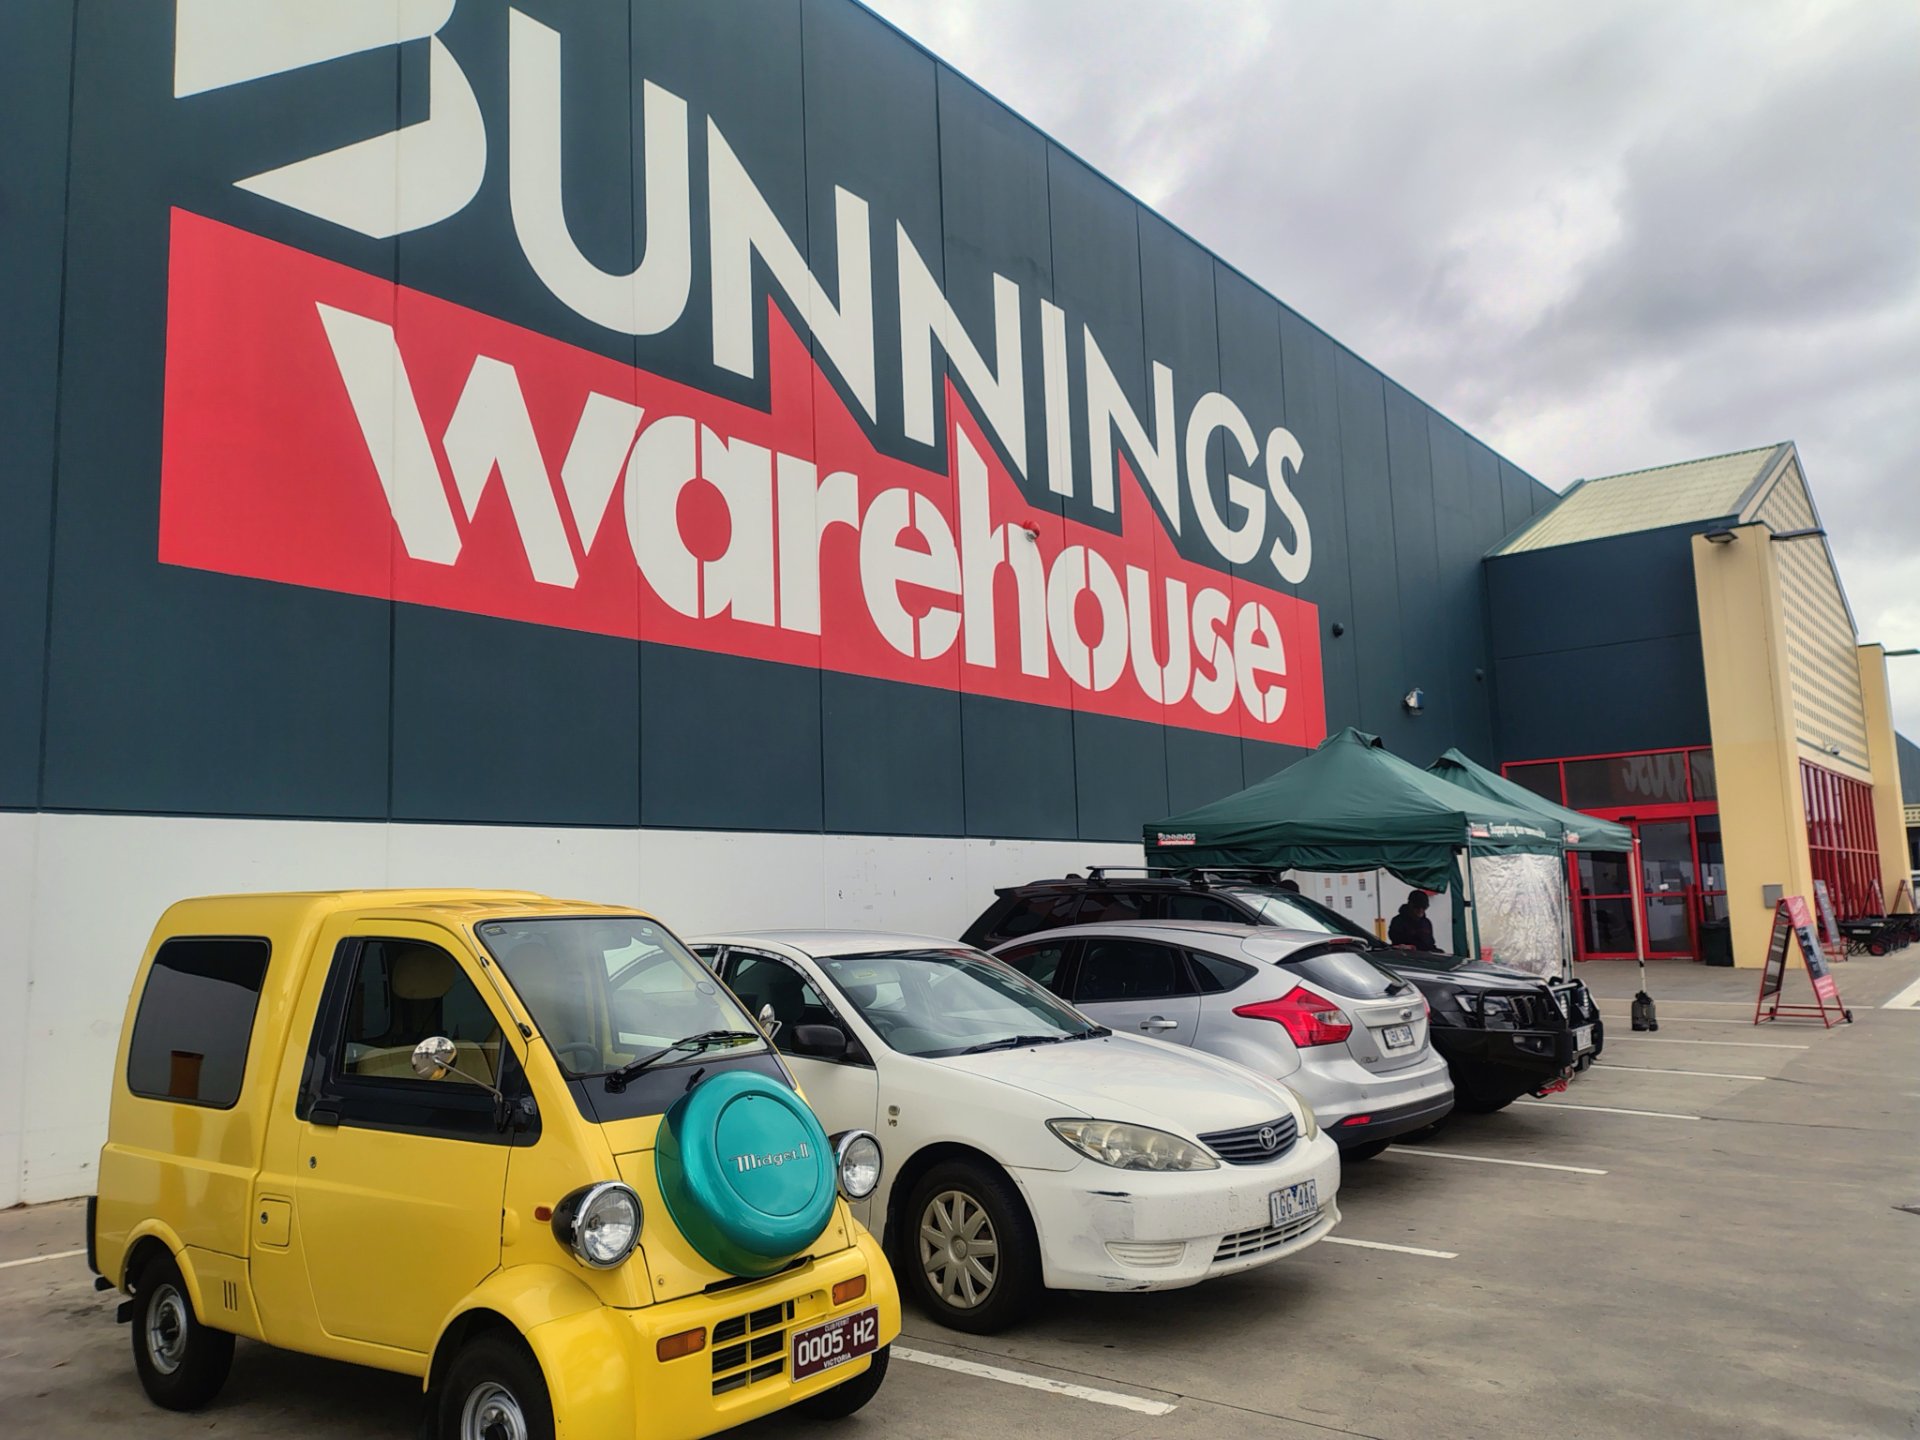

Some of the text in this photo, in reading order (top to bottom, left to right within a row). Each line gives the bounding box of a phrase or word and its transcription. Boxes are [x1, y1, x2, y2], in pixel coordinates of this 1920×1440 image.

[174, 0, 1312, 584] BUNNINGS
[315, 301, 1287, 724] warehouse
[823, 1352, 852, 1369] VICTORIA
